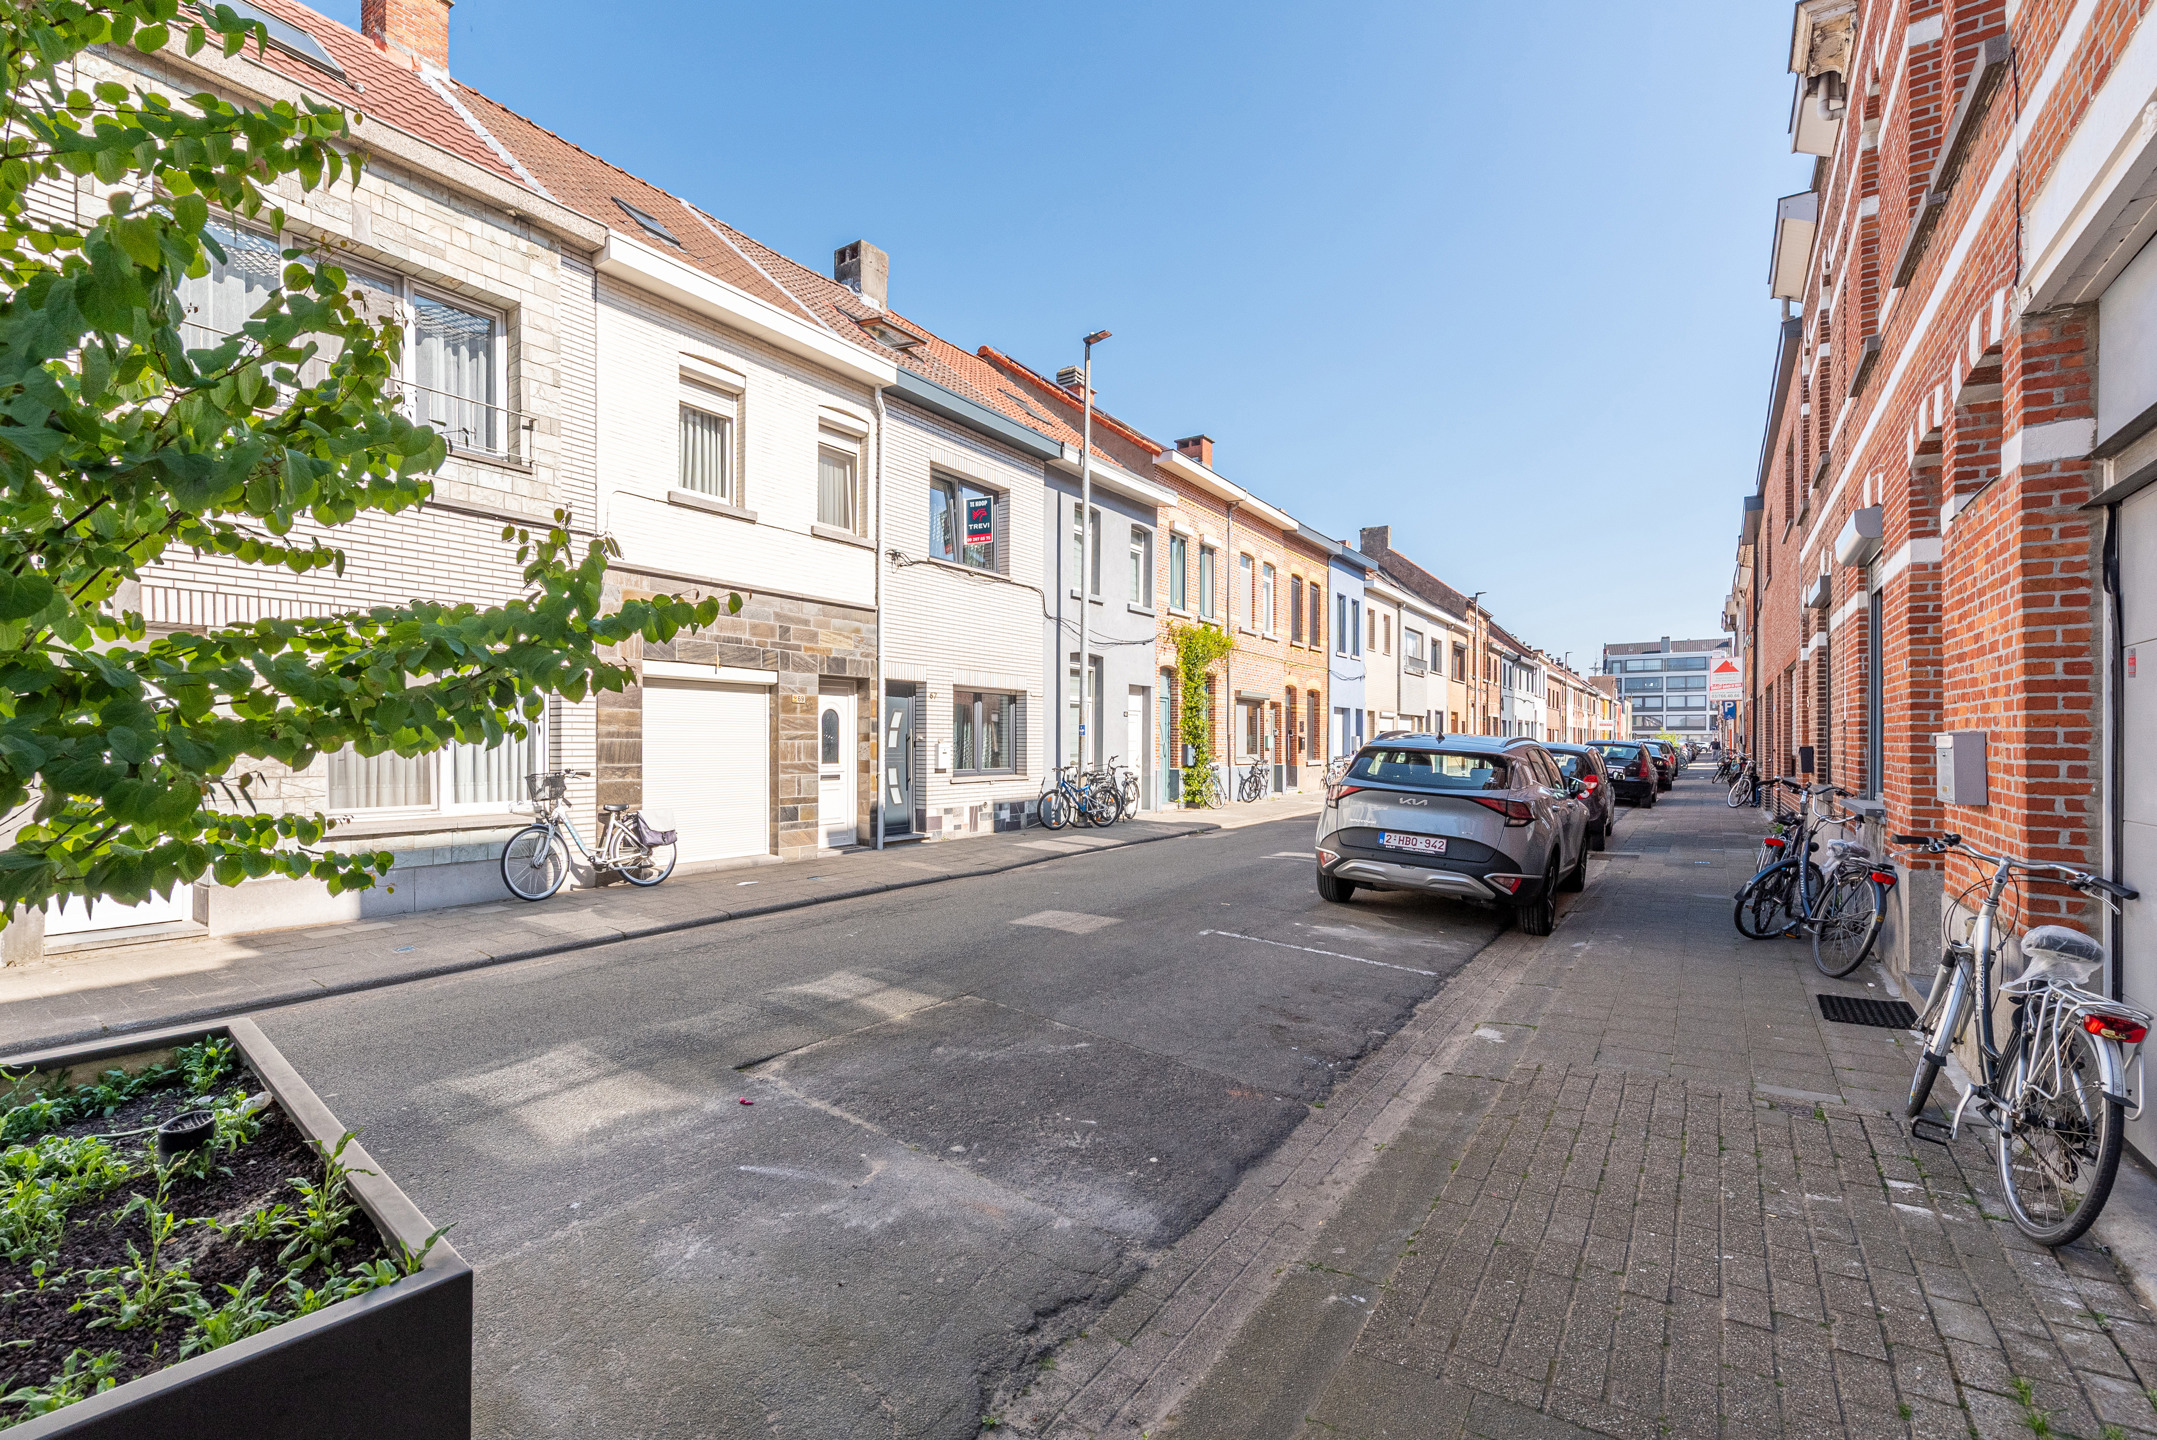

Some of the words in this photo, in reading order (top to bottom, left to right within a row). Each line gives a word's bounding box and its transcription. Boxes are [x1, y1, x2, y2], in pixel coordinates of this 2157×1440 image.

[1725, 701, 1734, 712] P
[1399, 797, 1428, 806] KIA
[1385, 834, 1445, 850] 2-HBQ-942
